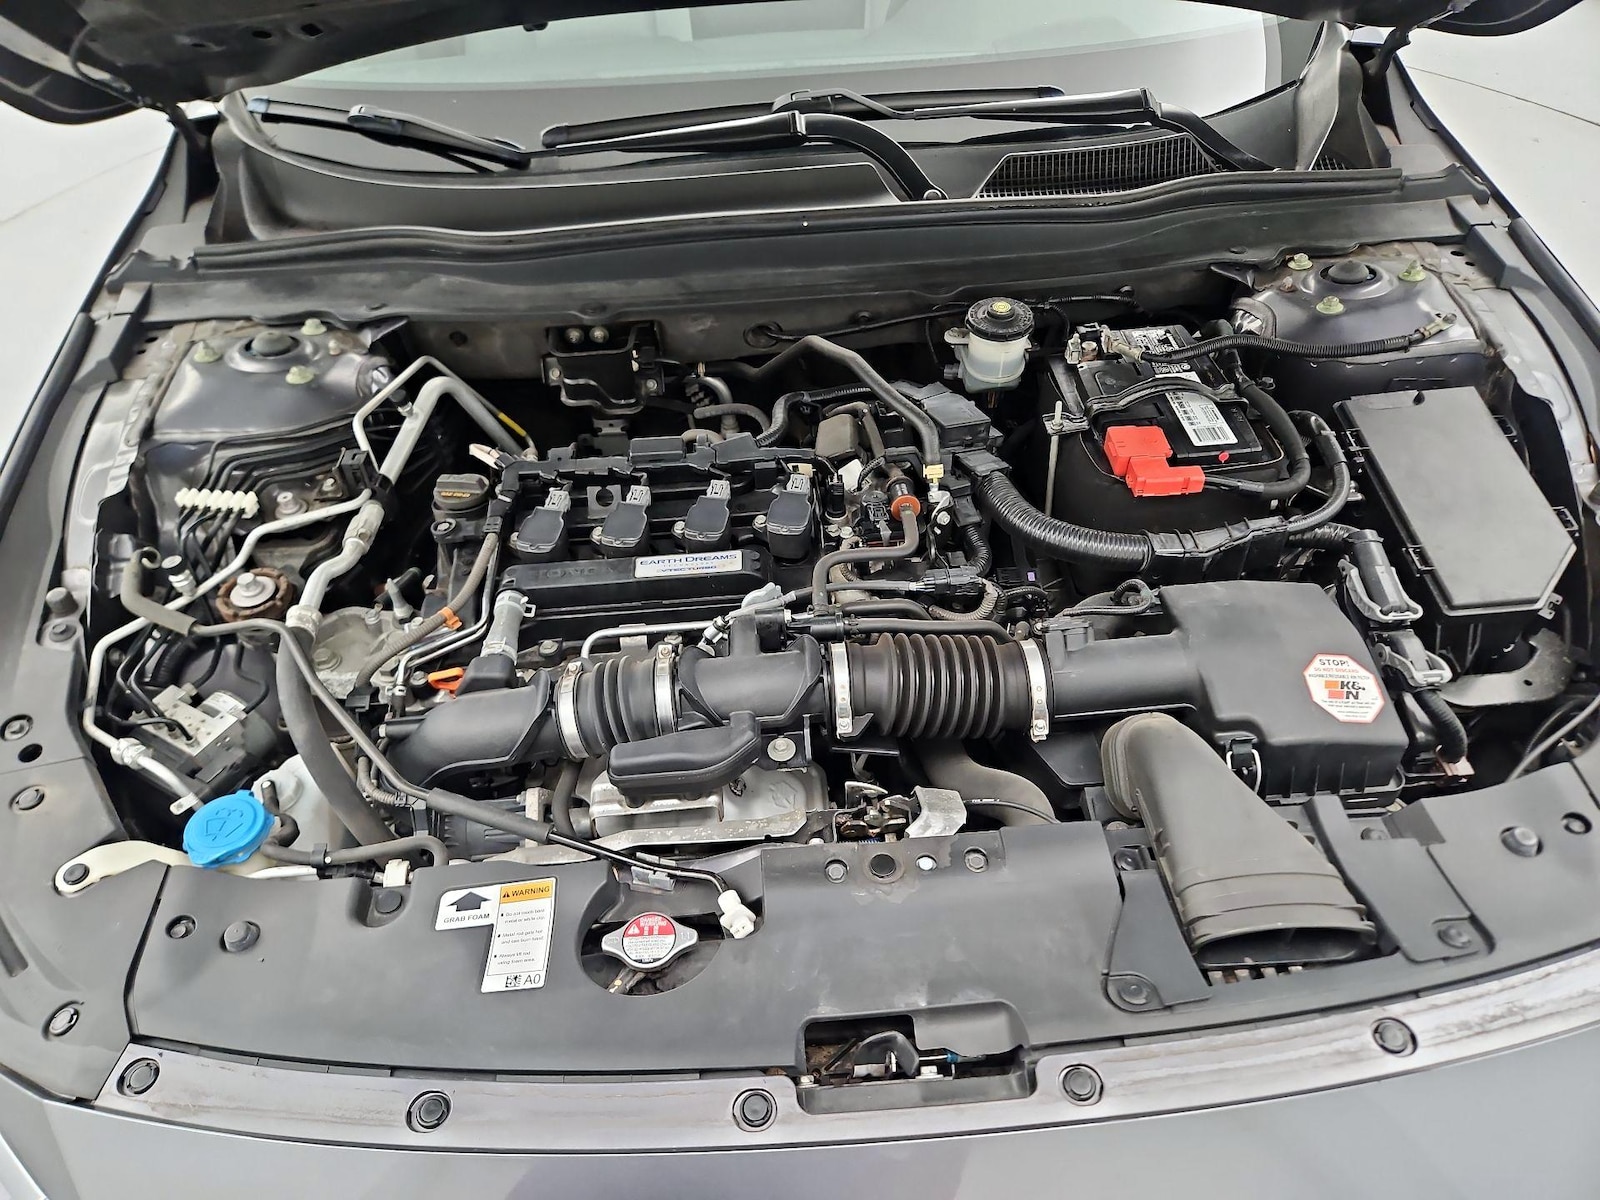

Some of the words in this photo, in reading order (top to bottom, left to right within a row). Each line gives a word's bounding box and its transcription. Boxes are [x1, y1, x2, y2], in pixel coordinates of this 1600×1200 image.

[1319, 659, 1350, 667] STOP!
[512, 886, 550, 897] WARNING
[444, 915, 466, 923] GRAB
[468, 913, 490, 921] FOAM
